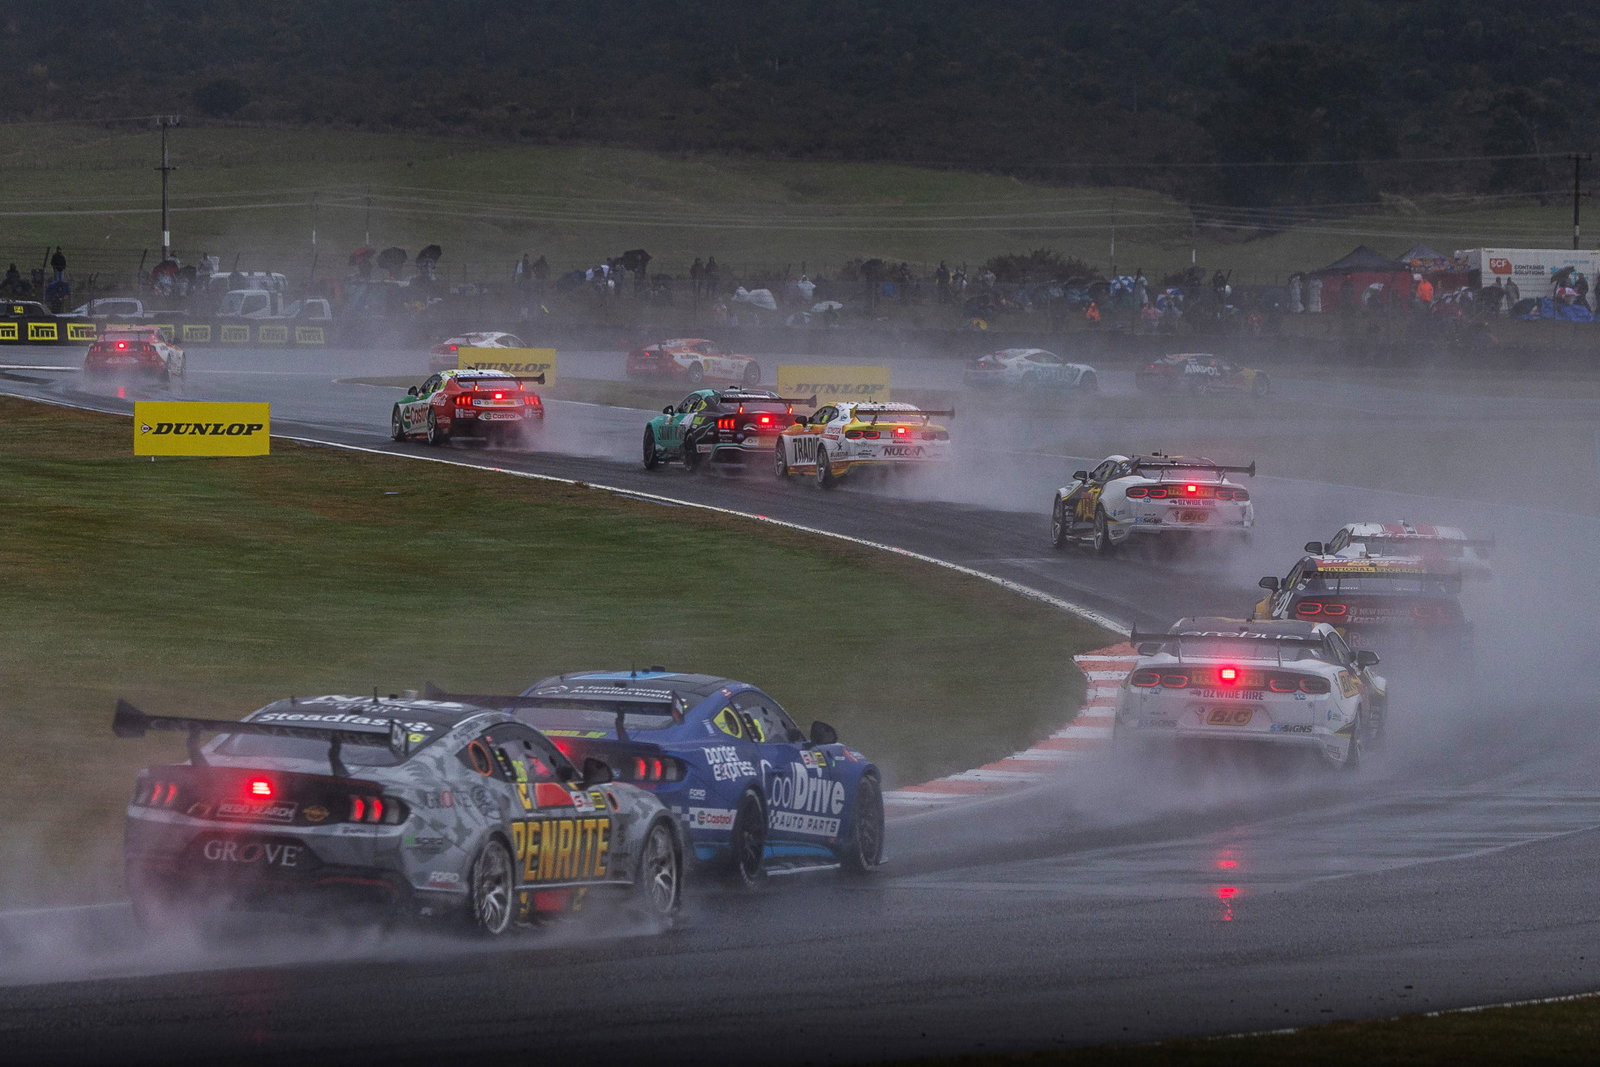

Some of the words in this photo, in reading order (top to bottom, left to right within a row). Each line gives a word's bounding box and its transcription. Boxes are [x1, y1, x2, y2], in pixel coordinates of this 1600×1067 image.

[1490, 259, 1507, 267] SCF
[473, 362, 551, 373] DUNLOP
[1185, 364, 1221, 376] AMPOL
[794, 383, 885, 395] DUNLOP
[492, 411, 517, 420] Castrol
[152, 422, 263, 436] DUNLOP
[883, 446, 921, 457] NULON
[1182, 511, 1207, 521] BIC
[1242, 691, 1264, 700] HIRE
[1210, 709, 1250, 723] BIC
[702, 745, 739, 765] border
[713, 761, 757, 782] express
[689, 788, 707, 797] FORD
[705, 812, 732, 825] Castrol
[779, 815, 804, 829] AUTO
[808, 818, 838, 833] PARTS
[203, 839, 298, 867] GROVE
[511, 818, 611, 881] PENRITE
[430, 871, 460, 882] FORD
